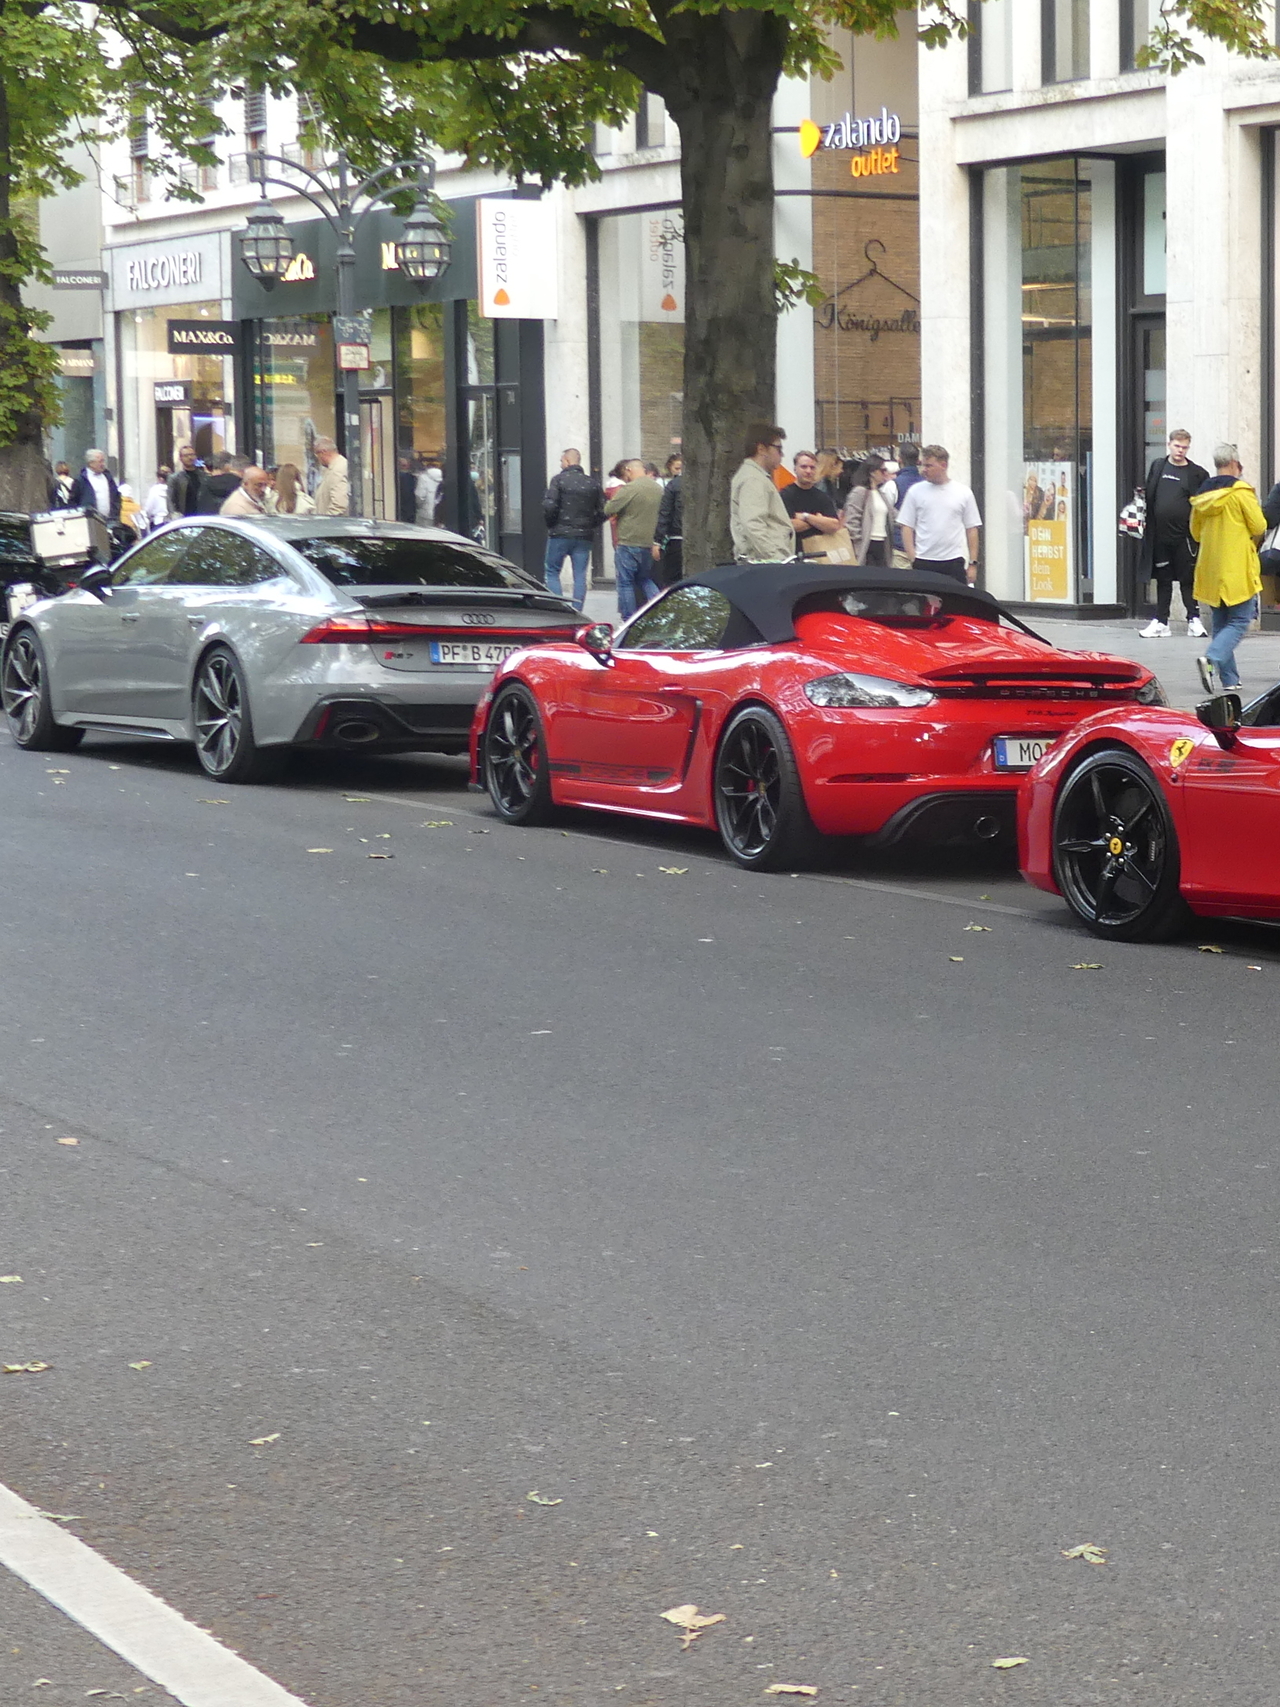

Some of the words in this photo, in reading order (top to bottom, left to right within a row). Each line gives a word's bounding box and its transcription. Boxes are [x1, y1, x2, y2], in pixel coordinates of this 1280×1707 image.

[822, 106, 901, 150] zalando
[851, 147, 899, 177] outlet
[493, 210, 507, 283] zalando
[127, 251, 201, 291] FALCONERI
[55, 275, 101, 285] FALCONERI
[1031, 527, 1051, 541] DEIN
[1031, 546, 1064, 559] HERBST
[1031, 561, 1051, 575] dein
[1032, 578, 1053, 591] Look
[441, 644, 461, 661] PF
[471, 645, 482, 661] B
[1019, 742, 1043, 762] MO
